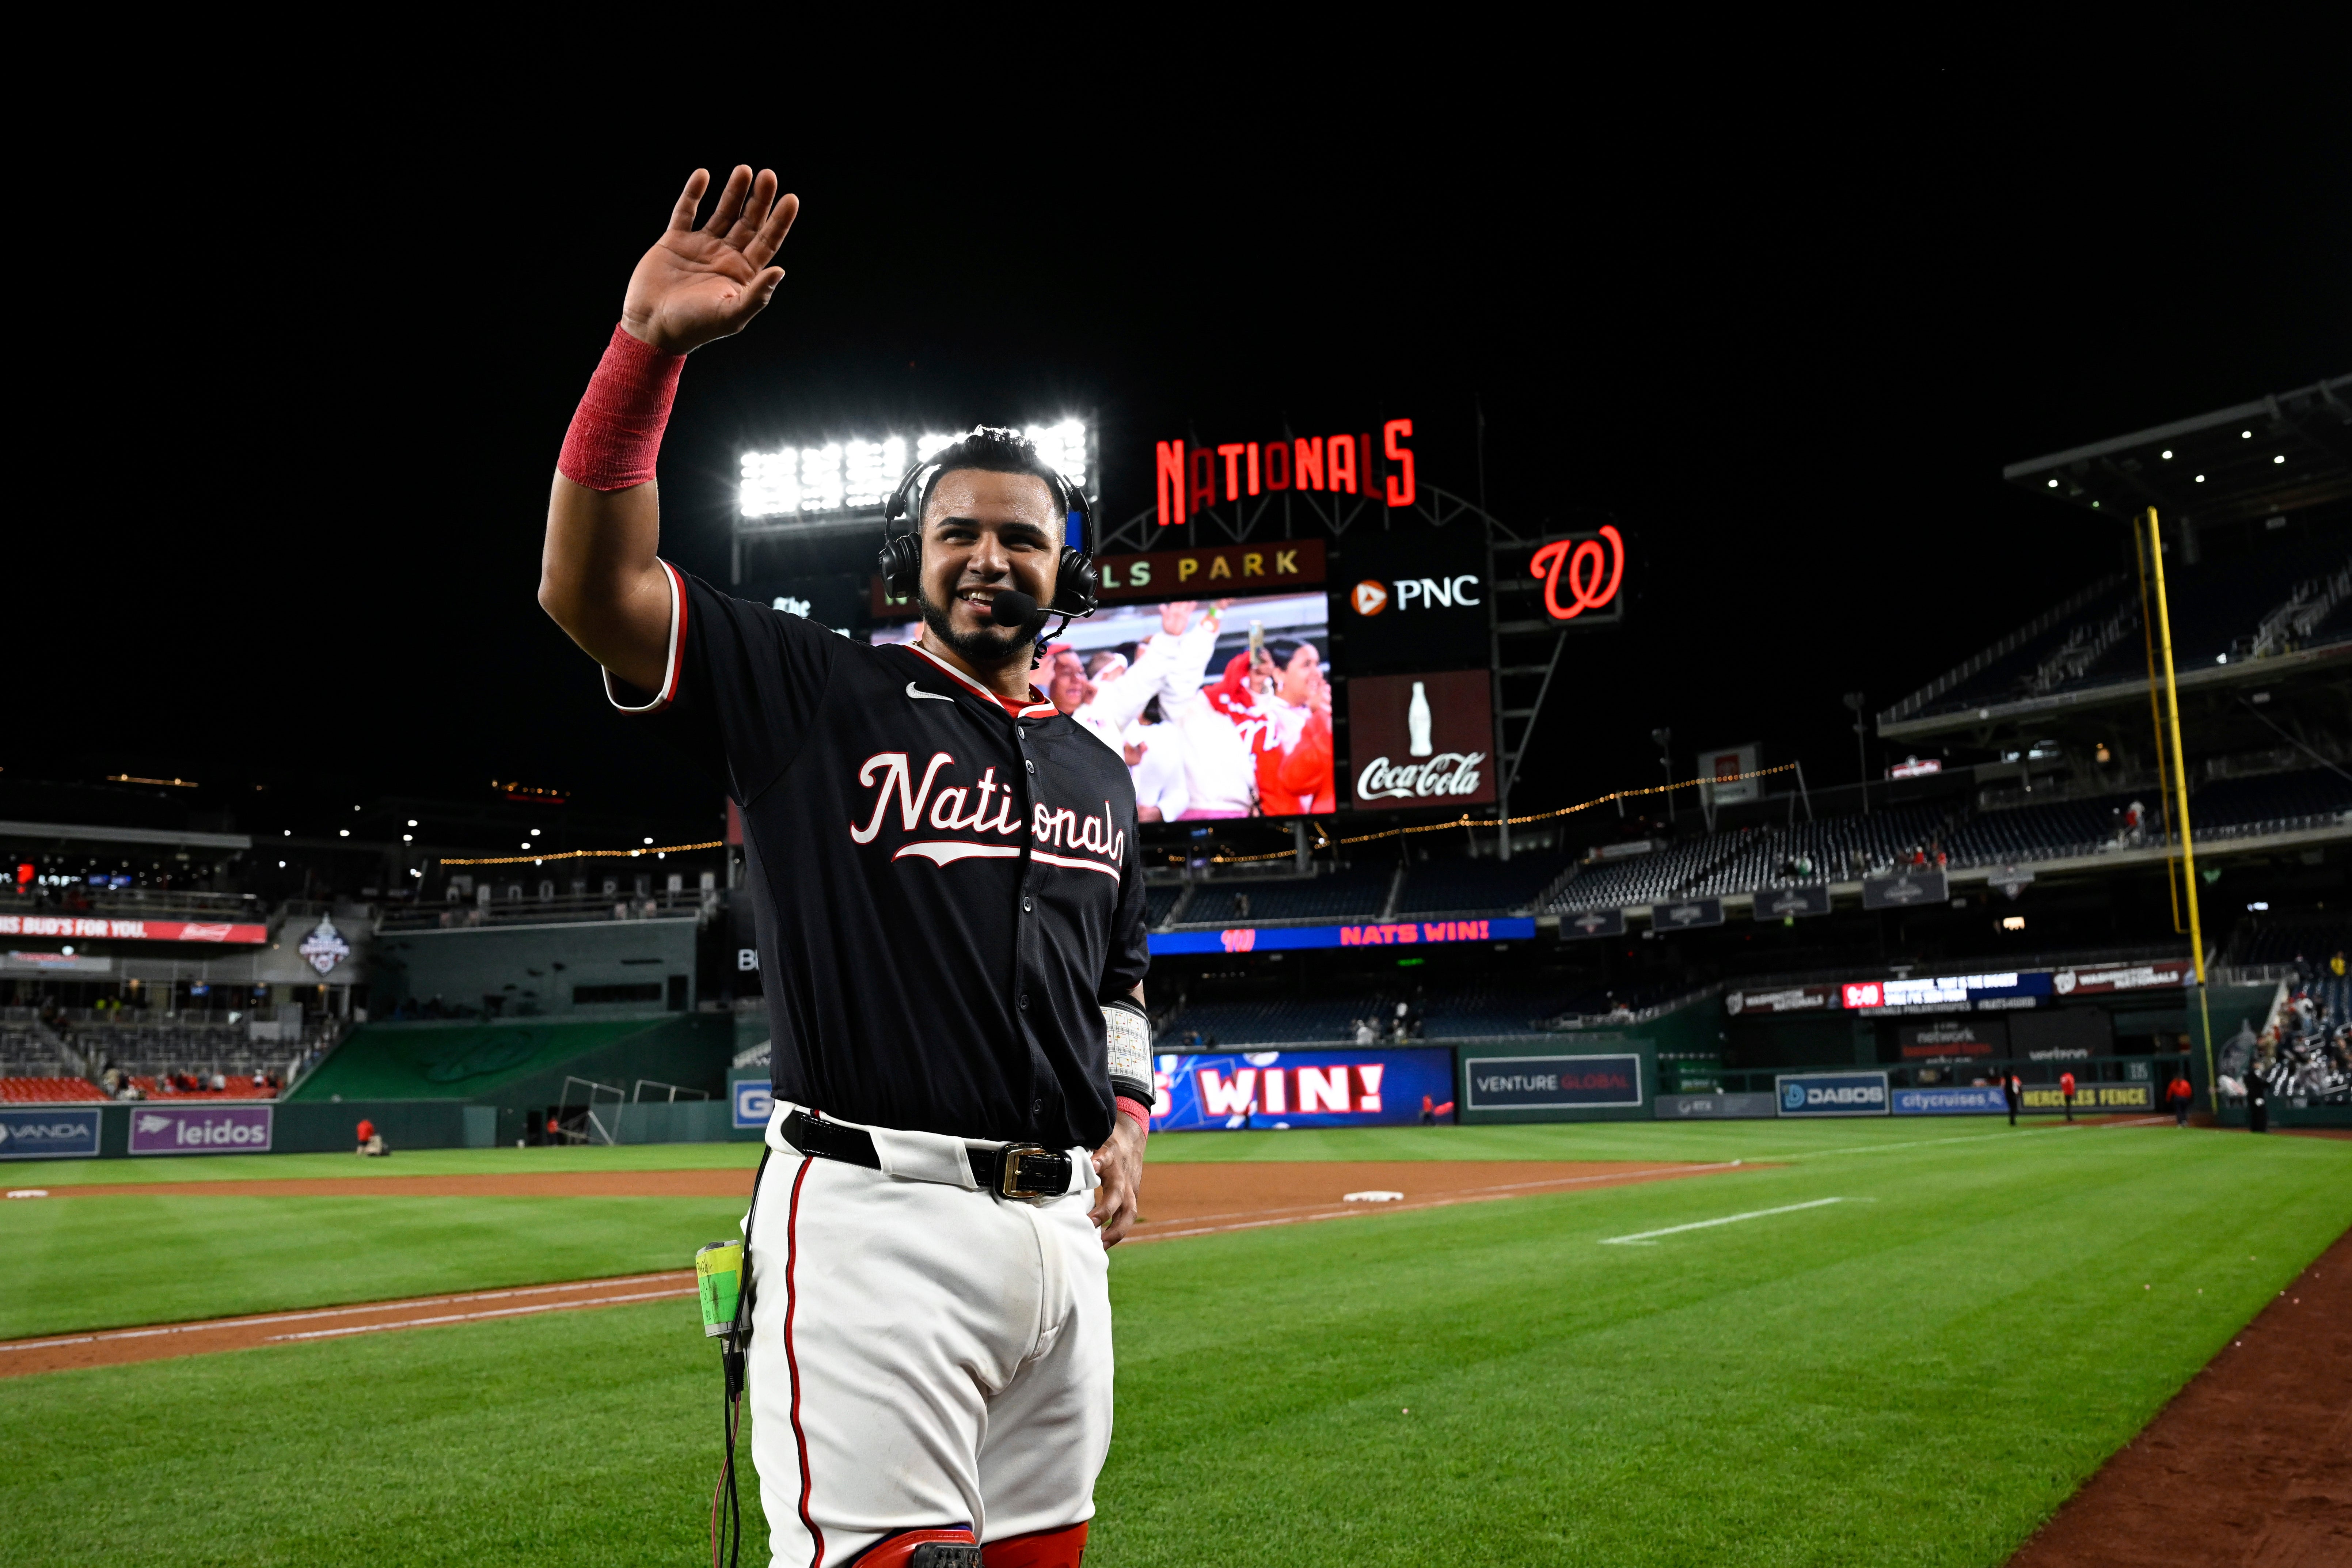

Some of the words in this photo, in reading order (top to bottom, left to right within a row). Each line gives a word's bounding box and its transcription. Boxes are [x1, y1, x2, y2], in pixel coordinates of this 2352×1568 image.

[1156, 419, 1415, 525] NATIONALS
[1178, 549, 1299, 582] PARK
[1393, 575, 1481, 611] PNC
[1357, 752, 1486, 800] Coca-Cola
[849, 751, 1125, 869] Nationals
[23, 917, 73, 936] BUD'S
[75, 919, 109, 937] FOR
[111, 920, 147, 938] YOU.
[1340, 925, 1418, 946] NATS
[1424, 920, 1490, 942] WIN!
[2079, 968, 2153, 985] WASHINGTON
[2114, 971, 2179, 989] NATIONALS
[1198, 1063, 1385, 1116] WIN!
[1477, 1075, 1558, 1092] VENTURE
[1561, 1072, 1629, 1089] GLOBAL
[1807, 1086, 1883, 1105] DABOS
[1902, 1093, 1986, 1111] citycruises
[2022, 1089, 2096, 1107] HERCLES
[2099, 1087, 2147, 1106] FENCE
[176, 1119, 265, 1145] leidos
